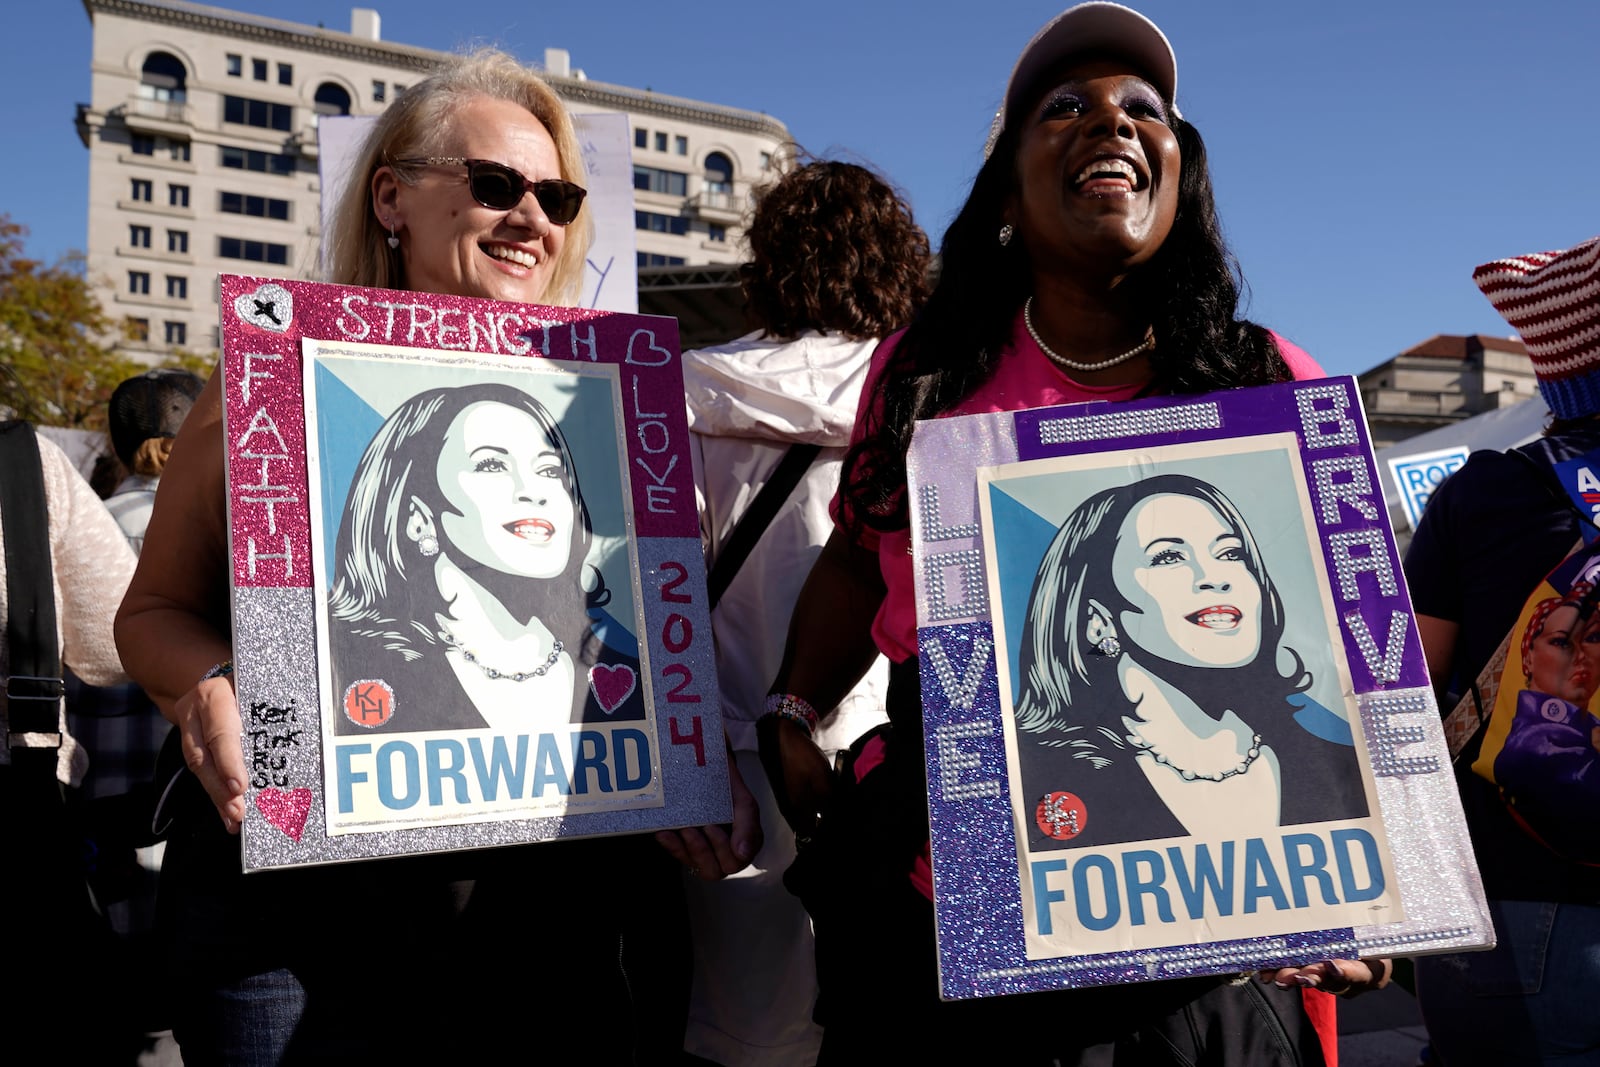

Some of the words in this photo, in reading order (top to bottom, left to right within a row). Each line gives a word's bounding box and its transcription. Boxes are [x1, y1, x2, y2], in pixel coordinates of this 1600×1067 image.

[336, 295, 598, 362] STRENGTH
[237, 352, 298, 580] FAITH
[631, 374, 679, 515] LOVE
[658, 560, 706, 768] 2024
[919, 484, 1000, 801] LOVE
[1295, 383, 1441, 778] BRAVE
[335, 728, 653, 814] FORWARD
[1030, 828, 1386, 936] FORWARD
